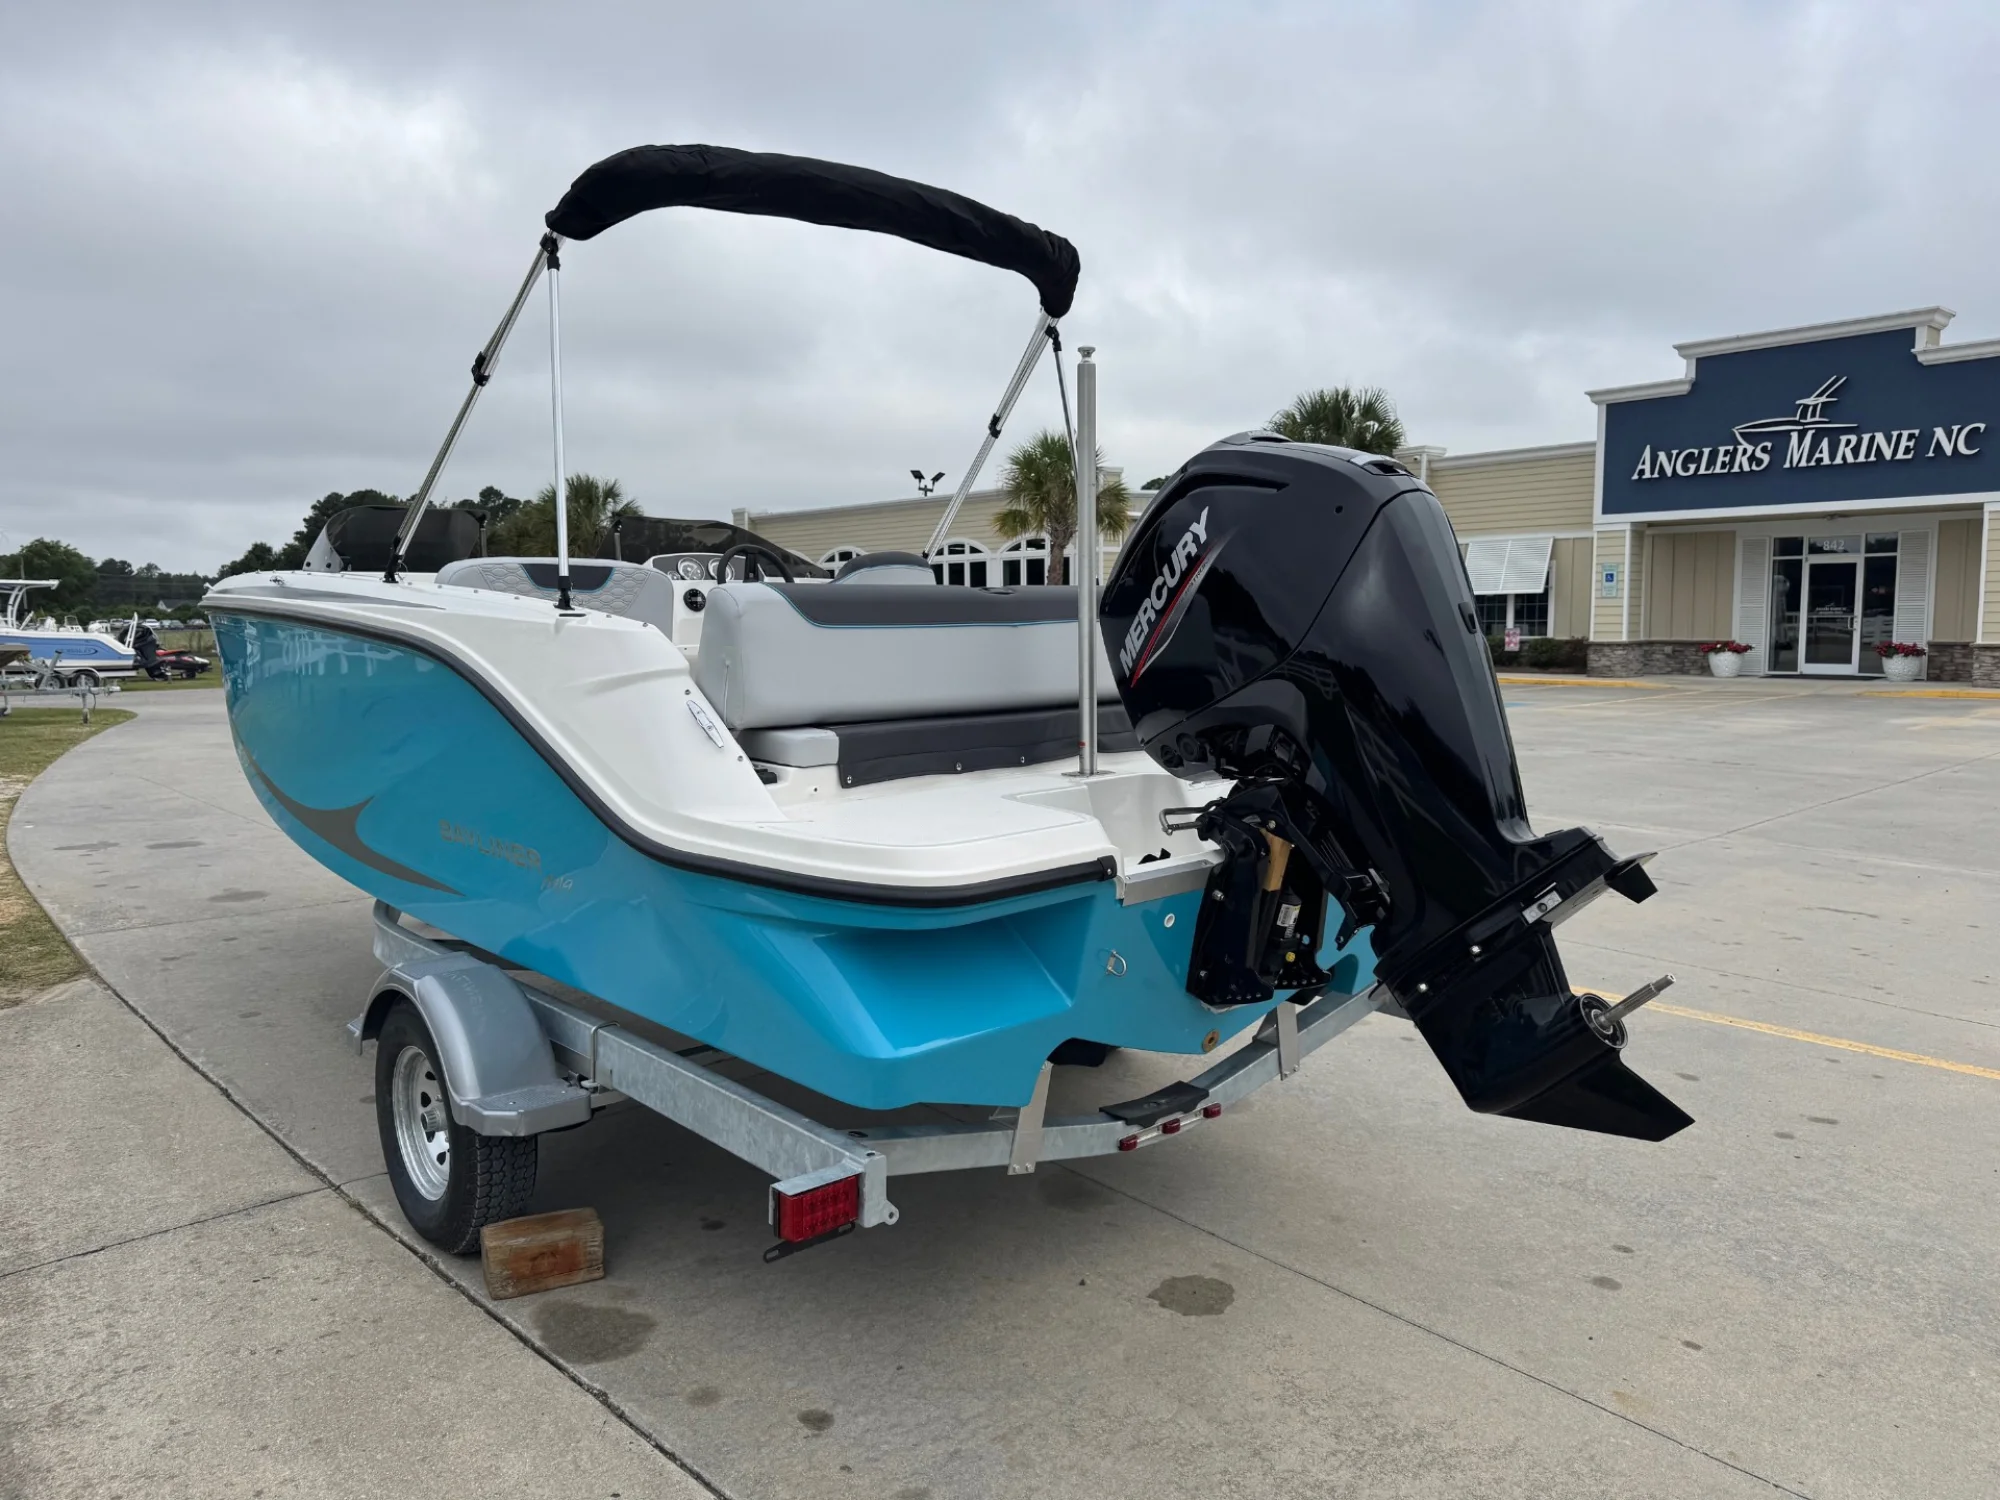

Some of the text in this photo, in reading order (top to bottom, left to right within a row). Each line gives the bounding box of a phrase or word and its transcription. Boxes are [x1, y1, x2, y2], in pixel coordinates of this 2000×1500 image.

[1631, 423, 1986, 480] ANGLERS MARINE NC
[1823, 539, 1845, 551] 842
[1119, 506, 1209, 678] MERCURY
[439, 818, 542, 874] BAYLINER
